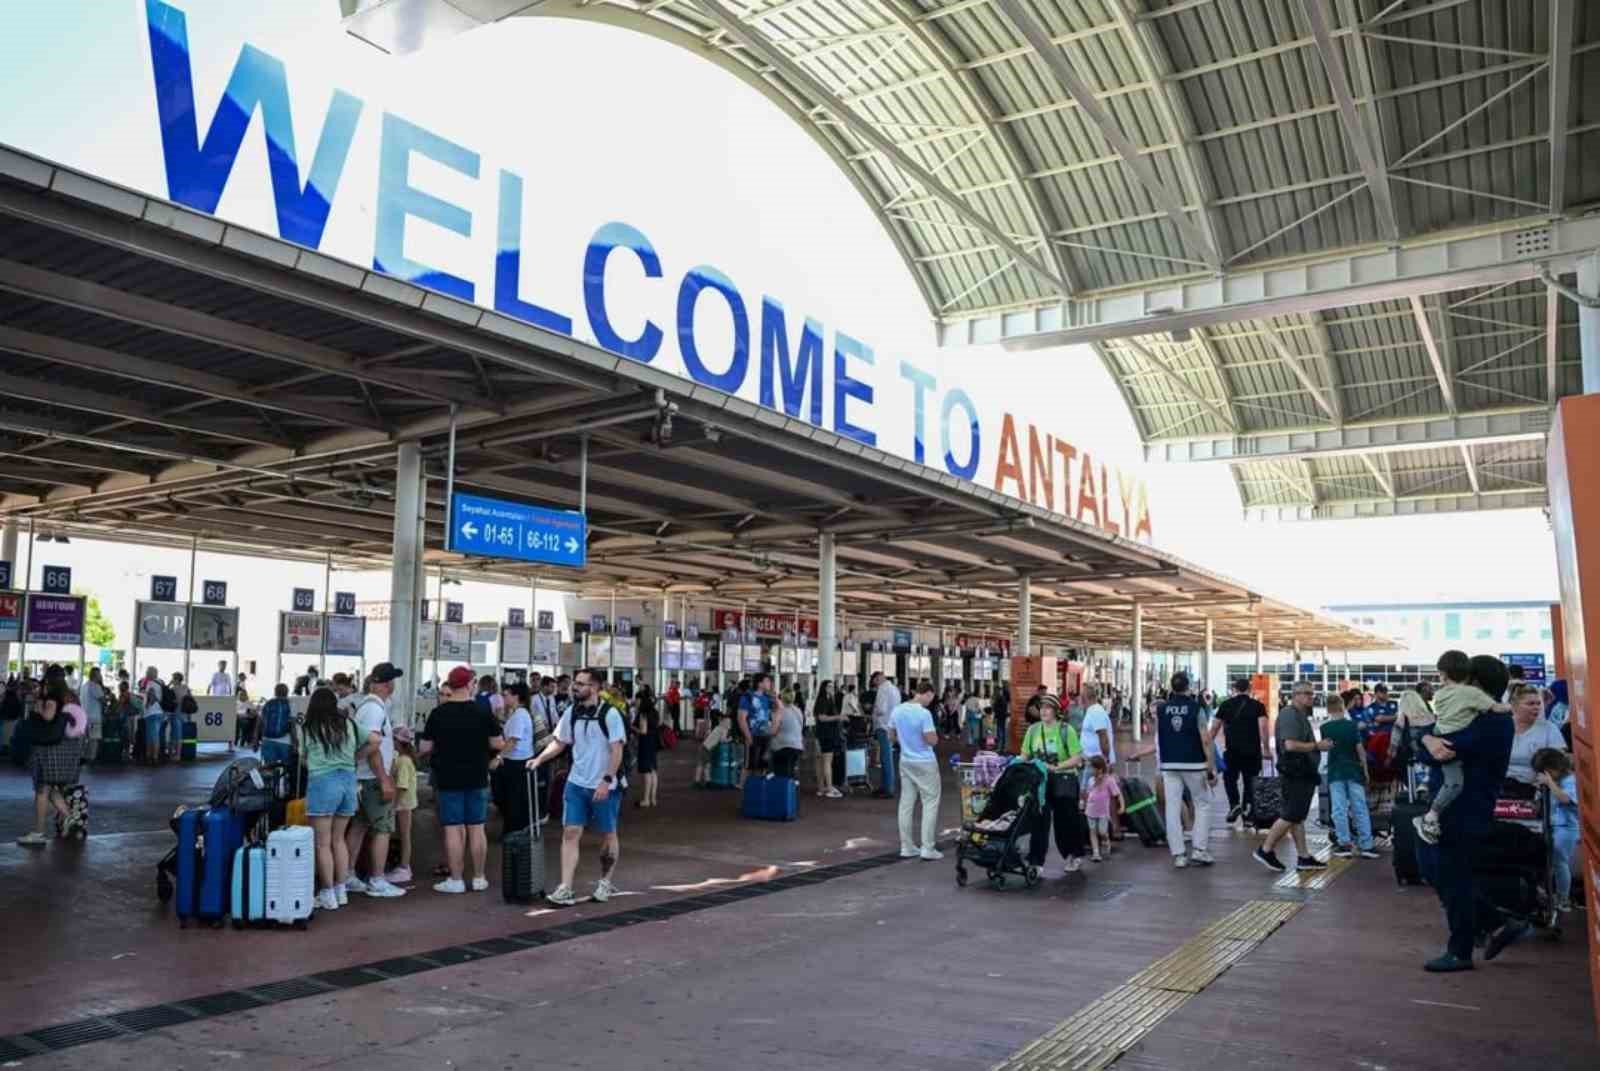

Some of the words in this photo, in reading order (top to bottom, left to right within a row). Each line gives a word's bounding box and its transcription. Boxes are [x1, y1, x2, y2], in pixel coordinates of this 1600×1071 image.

[145, 0, 877, 447] WELCOME
[899, 360, 980, 482] TO
[993, 411, 1153, 542] ANTALYA
[484, 523, 514, 545] 01-65
[526, 529, 560, 552] 66-112
[47, 571, 68, 587] 66
[155, 581, 175, 597] 67
[207, 585, 225, 600] 68
[296, 593, 312, 607] 69
[339, 596, 353, 610] 70
[741, 614, 776, 632] URGER
[204, 711, 223, 726] 68
